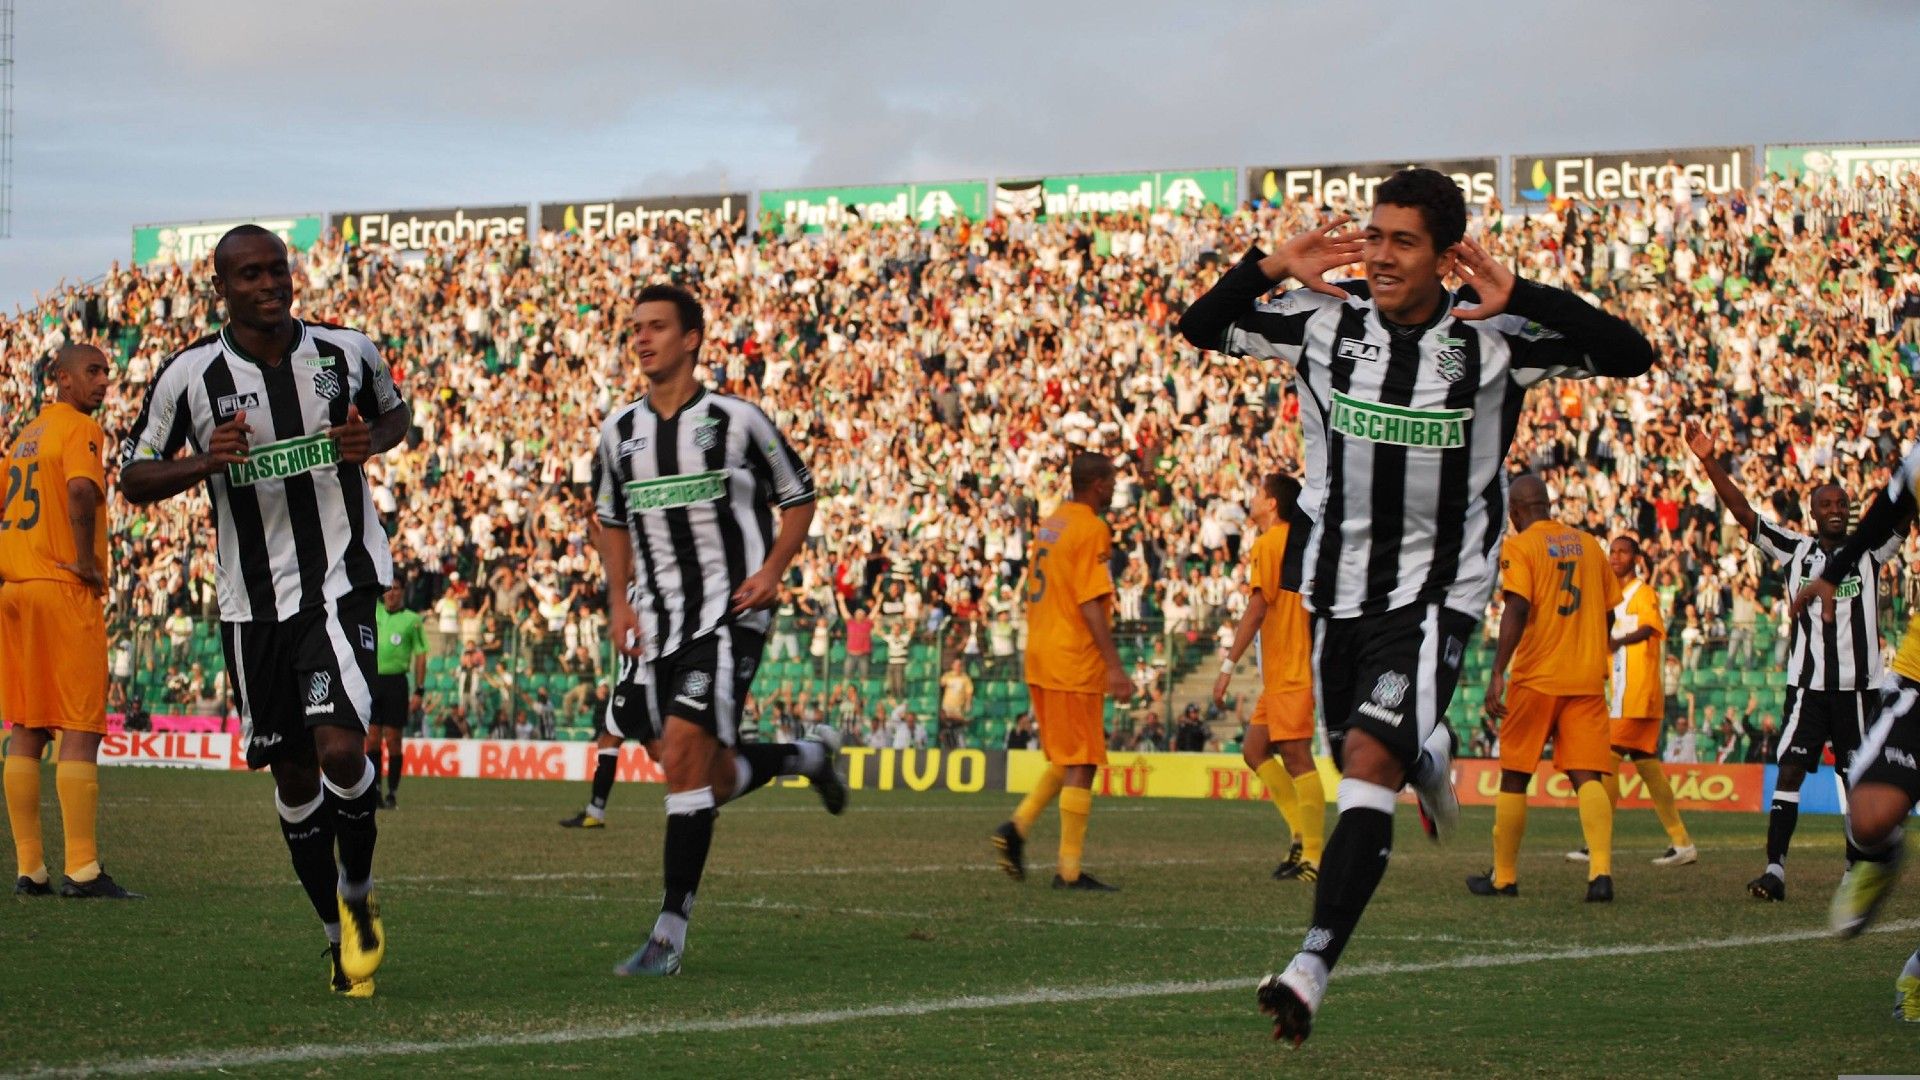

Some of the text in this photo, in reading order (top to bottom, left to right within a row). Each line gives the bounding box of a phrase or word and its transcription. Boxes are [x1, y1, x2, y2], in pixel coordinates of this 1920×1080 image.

[1339, 342, 1379, 362] FILA
[219, 393, 258, 415] FILA
[1333, 399, 1461, 447] TASCHIBRA
[228, 440, 341, 486] TASCHIBR
[1, 461, 41, 531] 25
[1557, 560, 1582, 617] 3
[102, 734, 221, 759] SKILL
[479, 743, 565, 780] BMG
